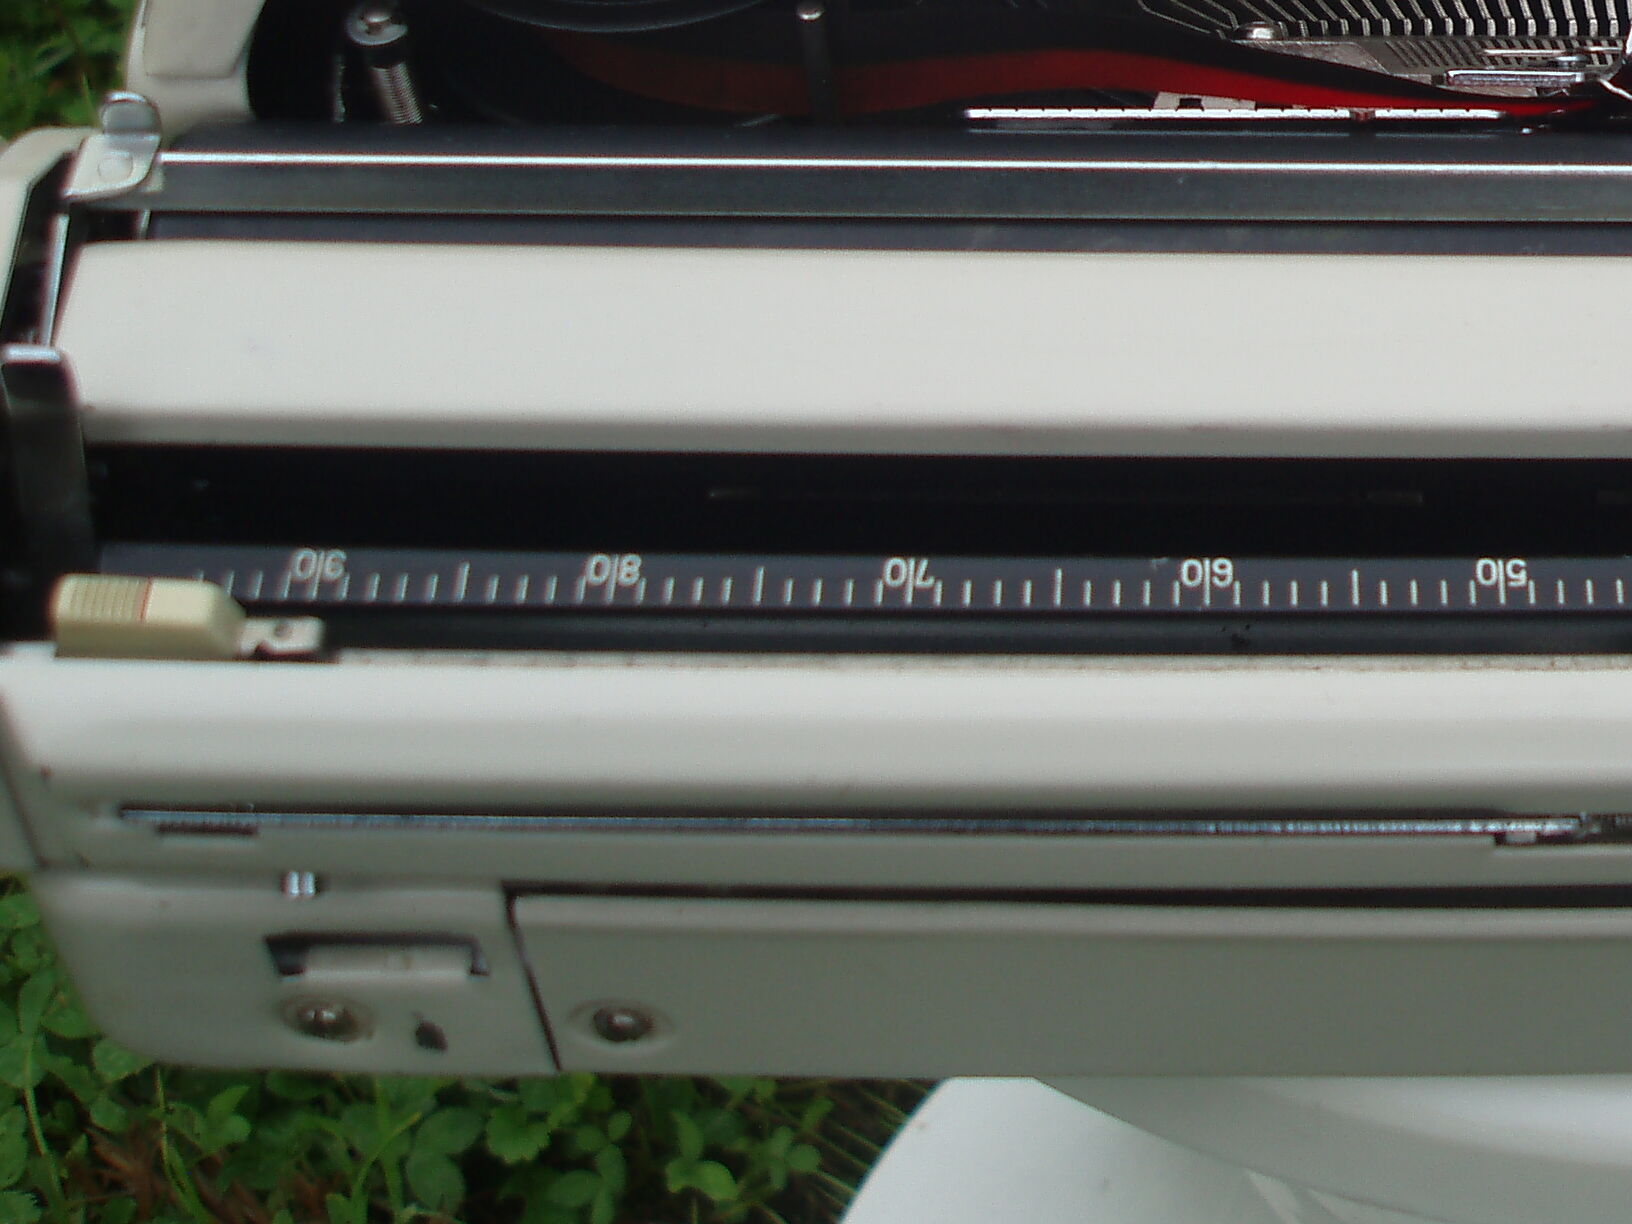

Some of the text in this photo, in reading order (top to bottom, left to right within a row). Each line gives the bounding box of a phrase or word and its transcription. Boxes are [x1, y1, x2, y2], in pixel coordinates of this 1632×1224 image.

[584, 554, 643, 587] 80
[883, 557, 935, 589] 70
[1180, 557, 1234, 589] 60
[1475, 557, 1529, 587] 50
